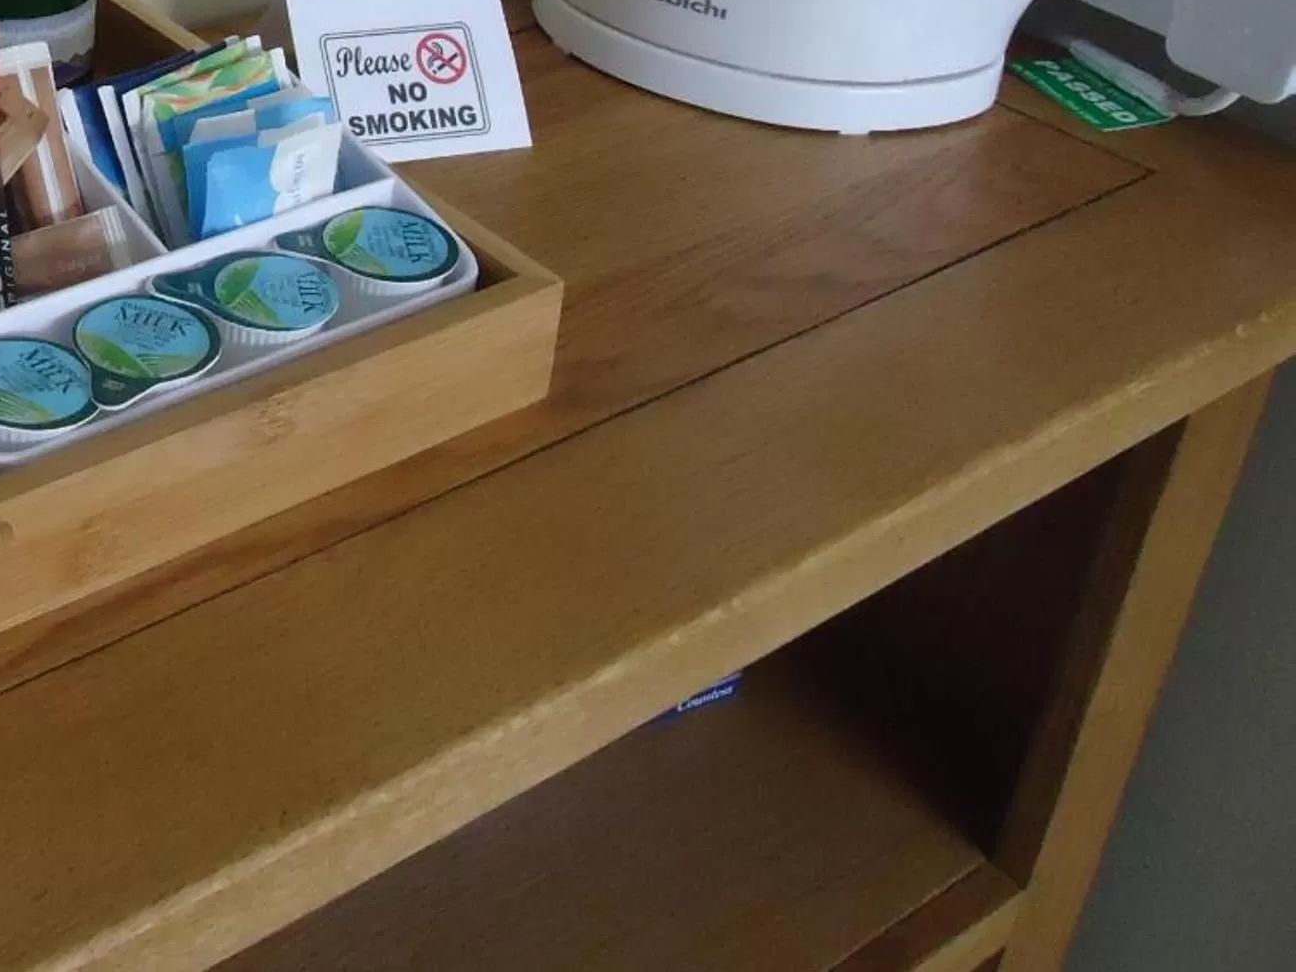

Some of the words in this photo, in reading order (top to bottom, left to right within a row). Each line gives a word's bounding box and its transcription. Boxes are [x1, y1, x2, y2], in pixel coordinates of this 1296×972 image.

[335, 46, 413, 78] Please
[387, 81, 428, 105] NO
[1033, 60, 1139, 123] PASSED
[348, 104, 478, 137] SMOKING
[0, 209, 16, 303] RIGINAL
[402, 221, 432, 264] MILK
